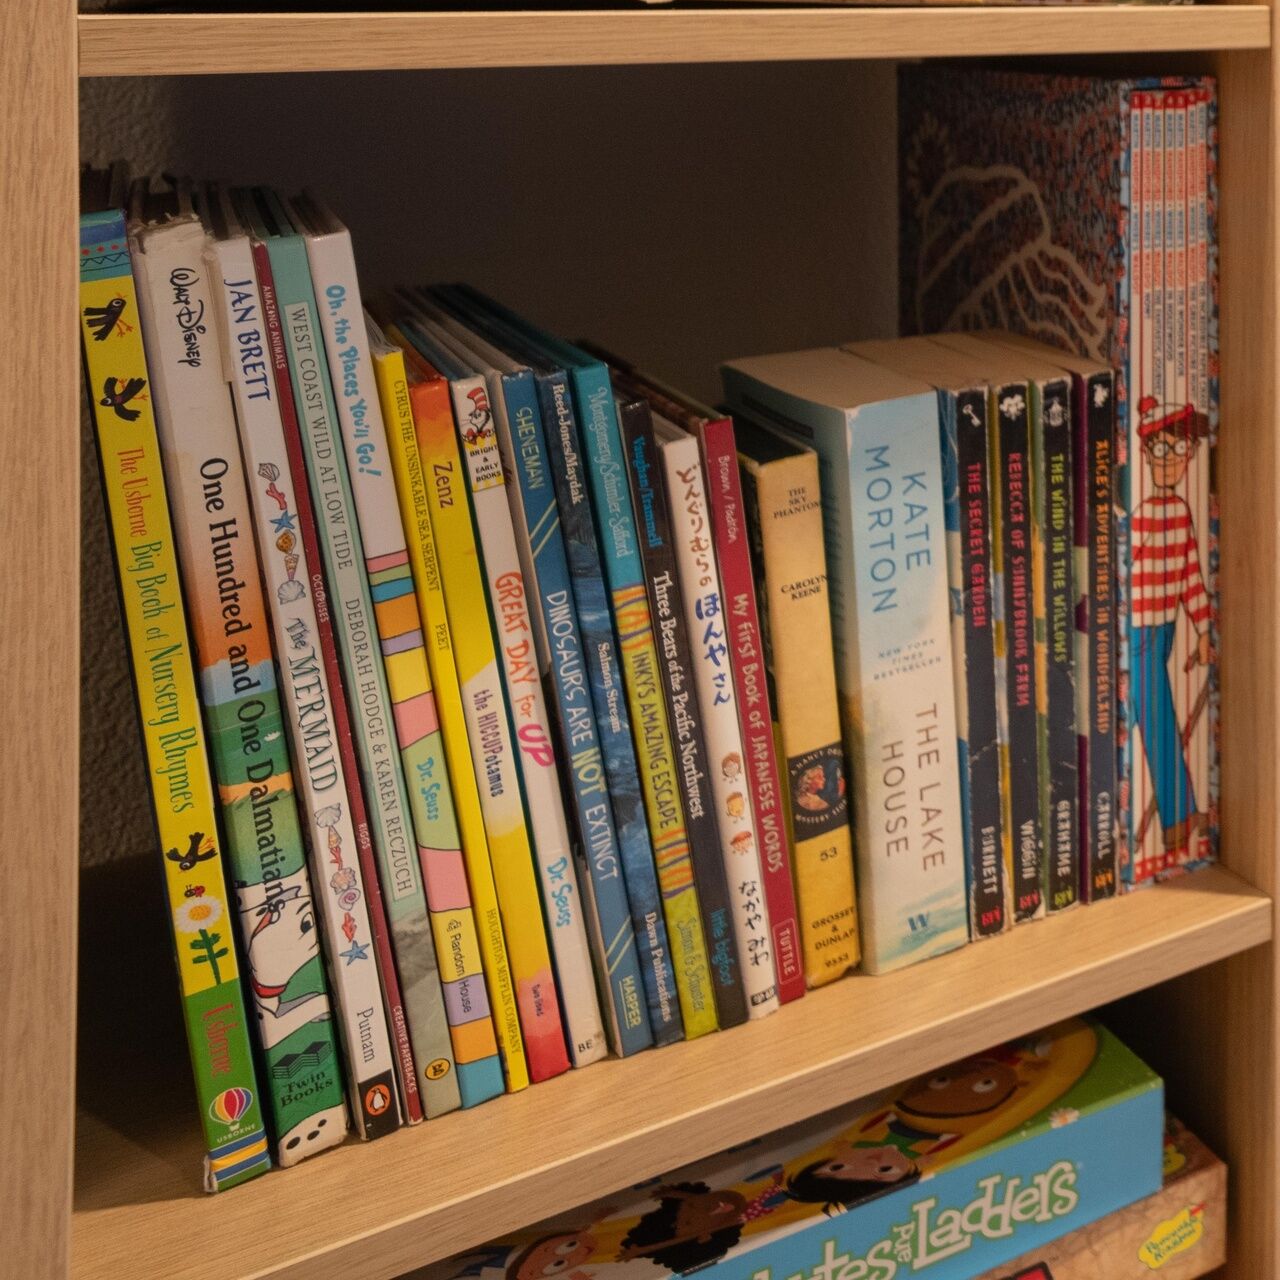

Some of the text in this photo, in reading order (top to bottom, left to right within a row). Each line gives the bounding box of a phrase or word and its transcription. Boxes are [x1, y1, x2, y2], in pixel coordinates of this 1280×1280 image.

[223, 279, 271, 401] JAN BRETT
[262, 285, 287, 370] AMAZING ANIMALS
[325, 284, 383, 477] Oh, the Places You'll Go!
[291, 307, 354, 570] WEST COAST WILD AT LOW TIDE
[394, 379, 440, 592] CYRUS UNSINKABLE SERPENT
[433, 460, 454, 509] Zenz
[516, 406, 545, 491] SHENEMAN
[864, 444, 900, 615] MORTON
[902, 468, 932, 571] KATE
[967, 462, 987, 628] THE SECRET GARDEN
[117, 446, 199, 814] The Usborne Big Book Nursery Rhymes
[312, 573, 329, 623] OCTOPUSES
[1008, 452, 1031, 707] REBECCA SUNNYBROOK FARM
[1095, 504, 1110, 736] ADVENTURES WONDERLAND
[435, 622, 449, 651] PEET
[495, 571, 556, 769] GREAT DAY UP
[597, 642, 621, 734] Salmon Stream
[874, 656, 942, 681] BESTSELLER
[199, 457, 287, 923] One Hundred and One Dalmatians
[285, 617, 339, 792] The MERMAID
[546, 589, 618, 881] DINOSAURS ARE NOT EXTINCT
[653, 570, 705, 820] Three Bears Pacific Northwest
[732, 592, 784, 873] My Book JAPANESE WORDS
[345, 598, 413, 894] DEBORAH HODGE KAREN RECZUCH
[640, 702, 678, 829] AMAZING ESCAPE
[881, 739, 909, 858] HOUSE
[915, 702, 946, 871] THE LAKE
[420, 783, 441, 822] Seuss
[819, 846, 838, 862] 53
[1056, 799, 1072, 877] GRAHAME
[550, 884, 573, 928] Seuss
[981, 825, 998, 894] BURNETT
[450, 932, 466, 977] Random
[458, 979, 473, 1013] House
[622, 975, 642, 1028] HARPER
[644, 911, 673, 1023] Dawn Publications
[779, 927, 796, 977] TUTTLE
[282, 1070, 326, 1094] Twin
[356, 1006, 376, 1063] Putnam
[216, 1123, 256, 1144] USBORNE
[280, 1078, 334, 1109] Books
[893, 1221, 915, 1263] and
[911, 1161, 1079, 1270] Ladders
